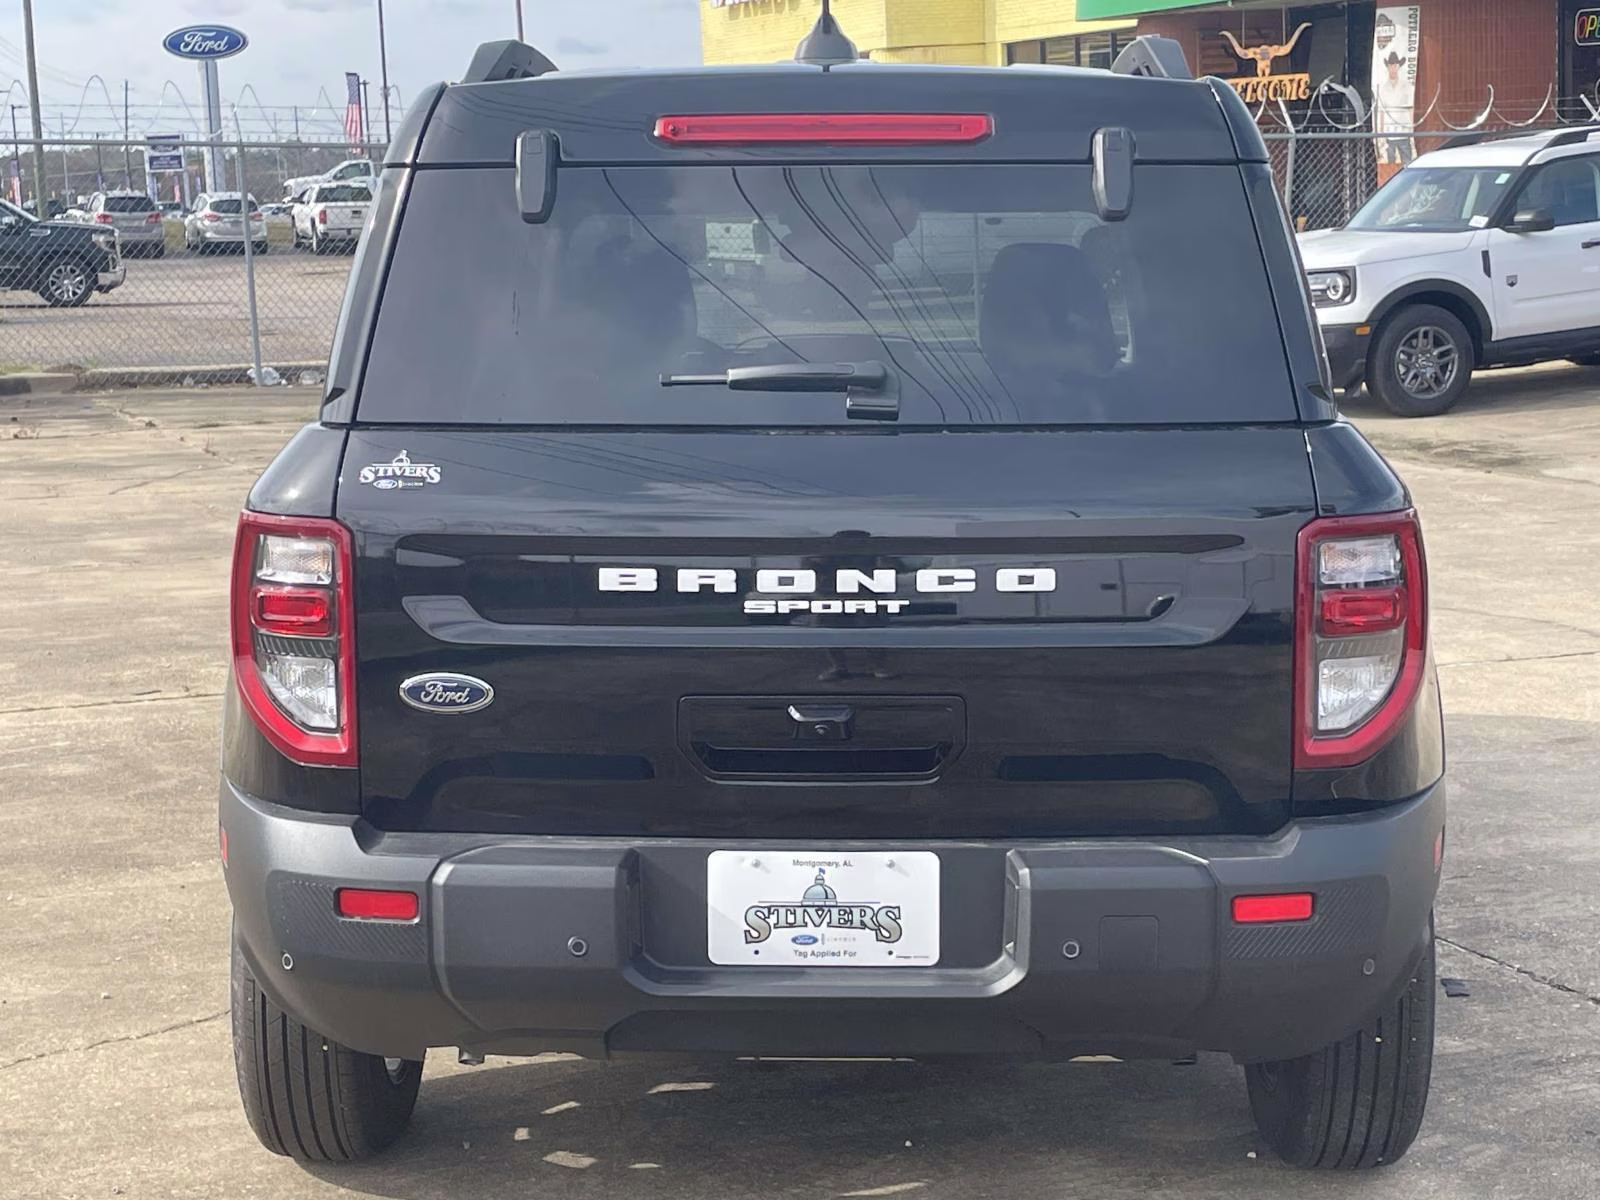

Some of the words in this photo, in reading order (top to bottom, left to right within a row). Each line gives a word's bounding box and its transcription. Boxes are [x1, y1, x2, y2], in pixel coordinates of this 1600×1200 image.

[180, 31, 229, 53] Ford
[1230, 76, 1311, 103] ELCOME
[359, 467, 441, 483] STIVERS
[598, 567, 1057, 593] BRONCO
[743, 600, 910, 614] SPORT
[420, 680, 471, 704] Ford
[792, 859, 841, 868] Montgomery,
[843, 859, 854, 867] AL
[744, 905, 903, 944] STIVERS
[793, 949, 808, 958] Tag
[810, 949, 841, 957] Applied
[843, 949, 857, 957] For
